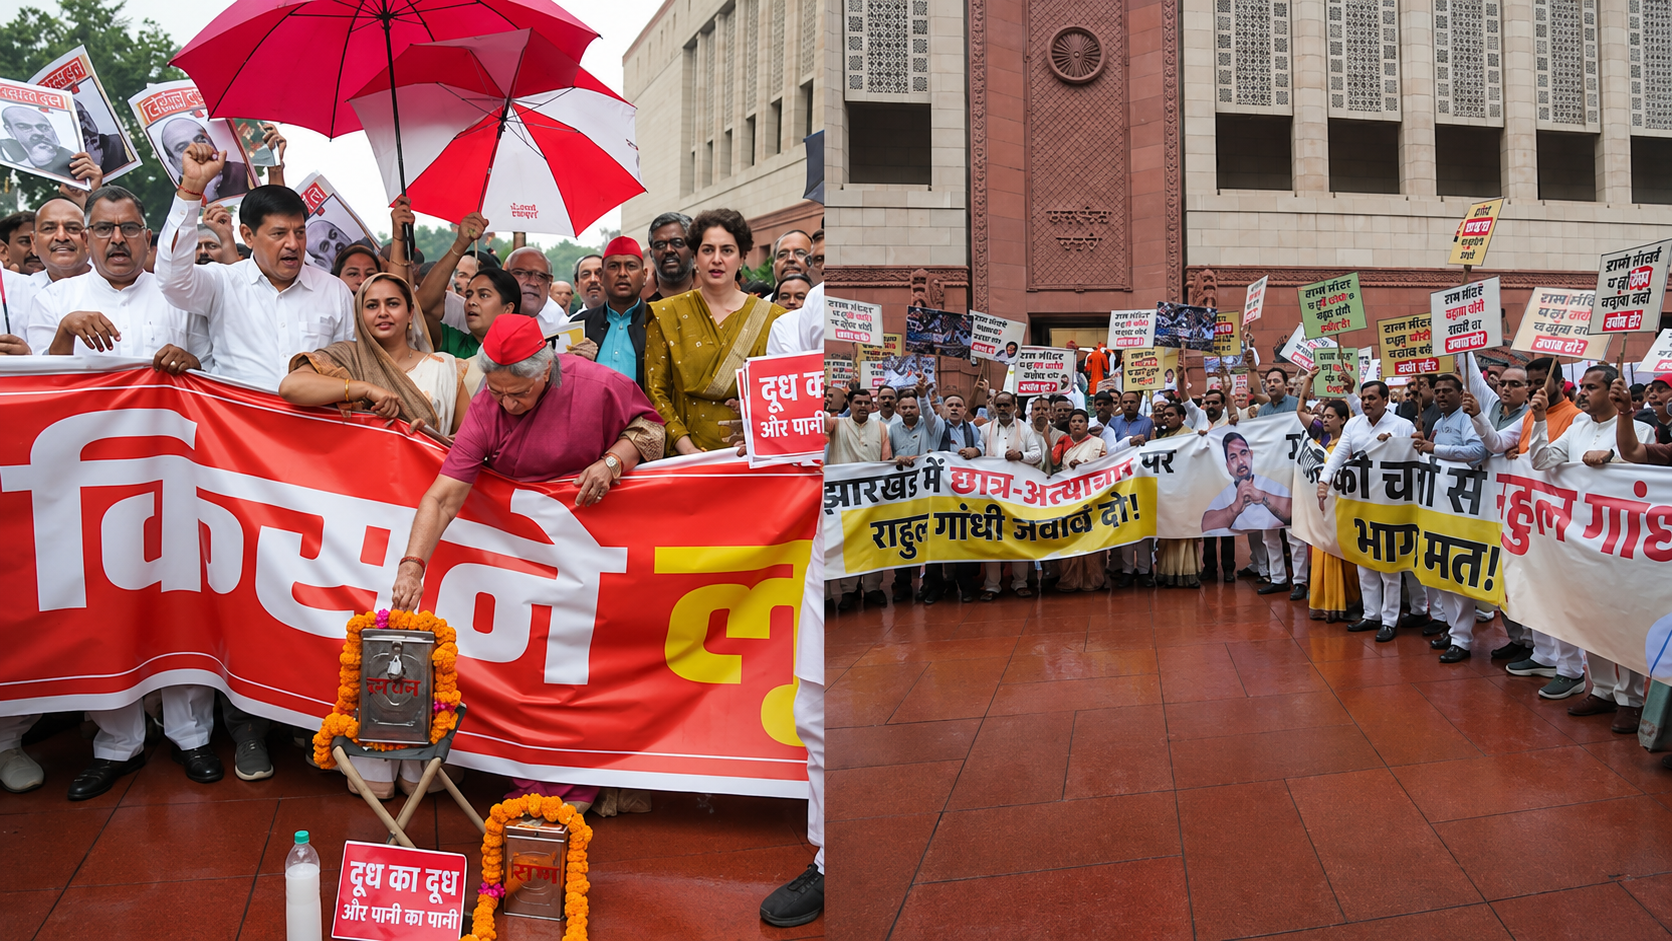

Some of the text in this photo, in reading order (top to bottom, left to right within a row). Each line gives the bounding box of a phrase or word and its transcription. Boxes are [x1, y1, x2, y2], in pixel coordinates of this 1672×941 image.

[758, 373, 798, 414] दूध
[922, 456, 945, 493] में
[1140, 449, 1178, 474] पर
[933, 503, 1006, 541] गांधी
[1098, 491, 1140, 529] दो!
[1423, 530, 1501, 592] मत!
[350, 860, 460, 905] दूध का दूध
[341, 897, 459, 930] और पानी का पानी
